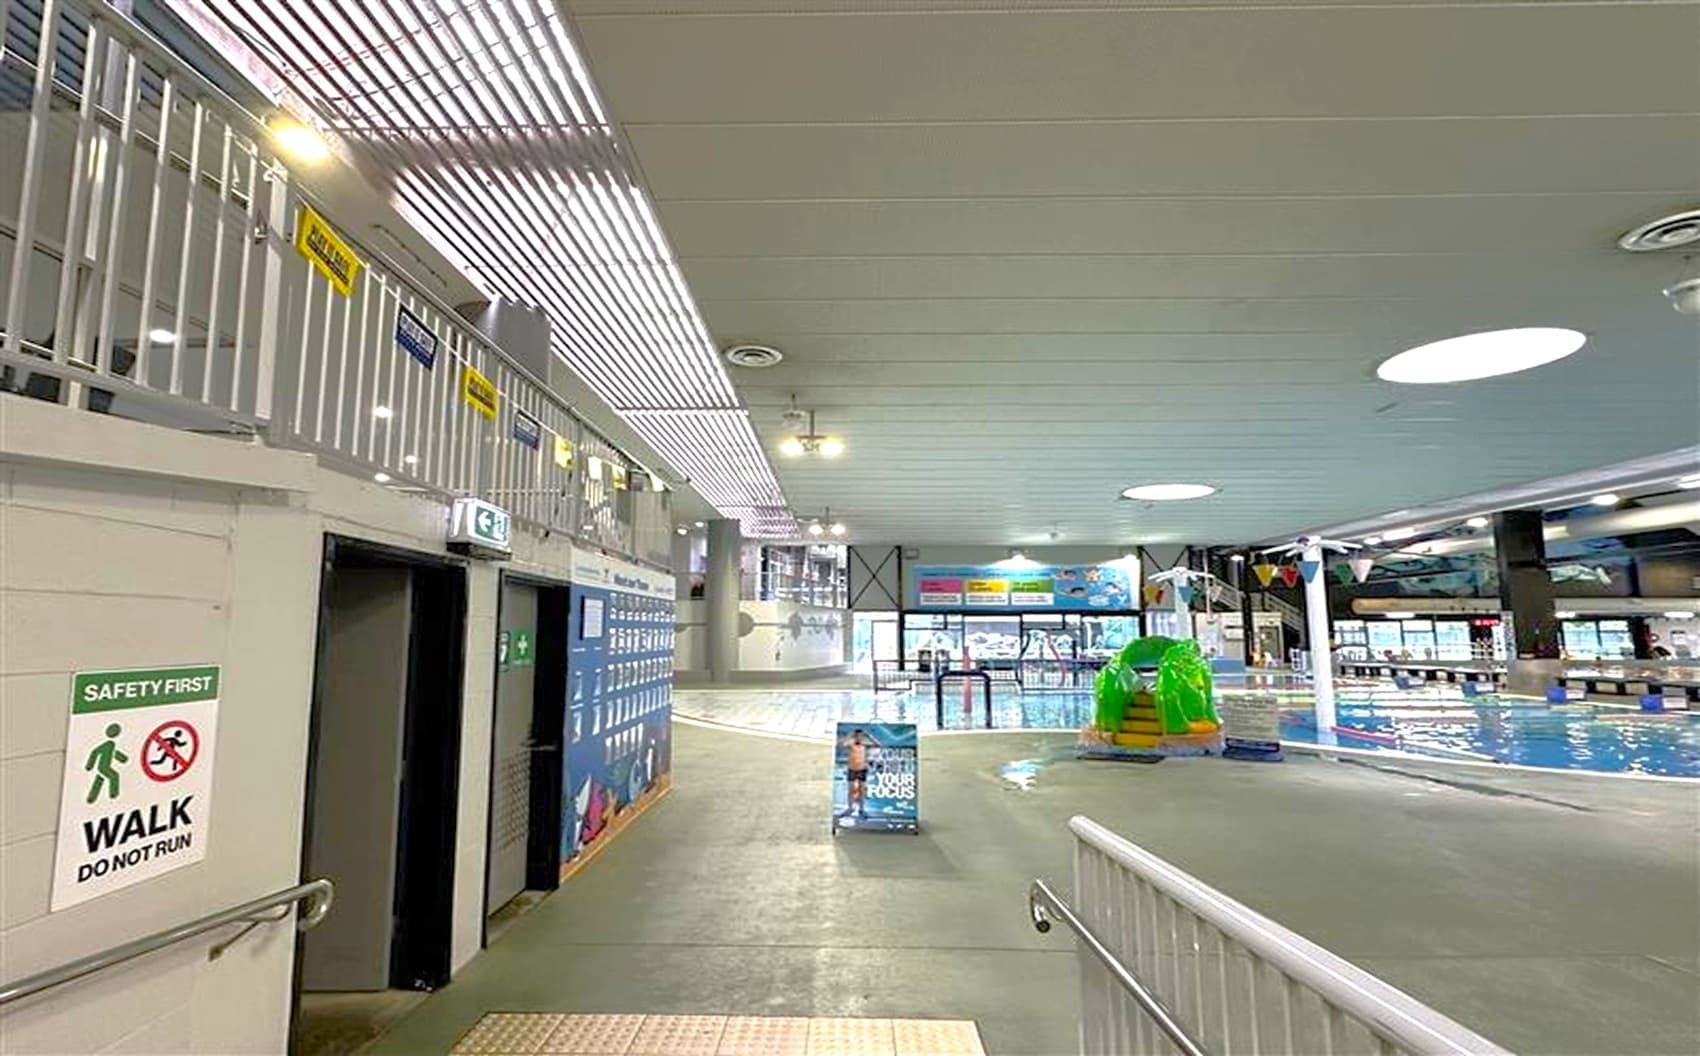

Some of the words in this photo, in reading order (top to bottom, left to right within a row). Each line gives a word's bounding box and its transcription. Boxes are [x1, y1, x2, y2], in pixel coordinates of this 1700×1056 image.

[83, 679, 162, 702] SAFETY
[164, 676, 213, 694] FIRST
[867, 784, 916, 800] FOCUS
[876, 772, 915, 787] YOUR
[83, 795, 194, 853] WALK
[77, 859, 110, 883] DO
[111, 844, 152, 871] NOT
[155, 833, 193, 858] RUN
